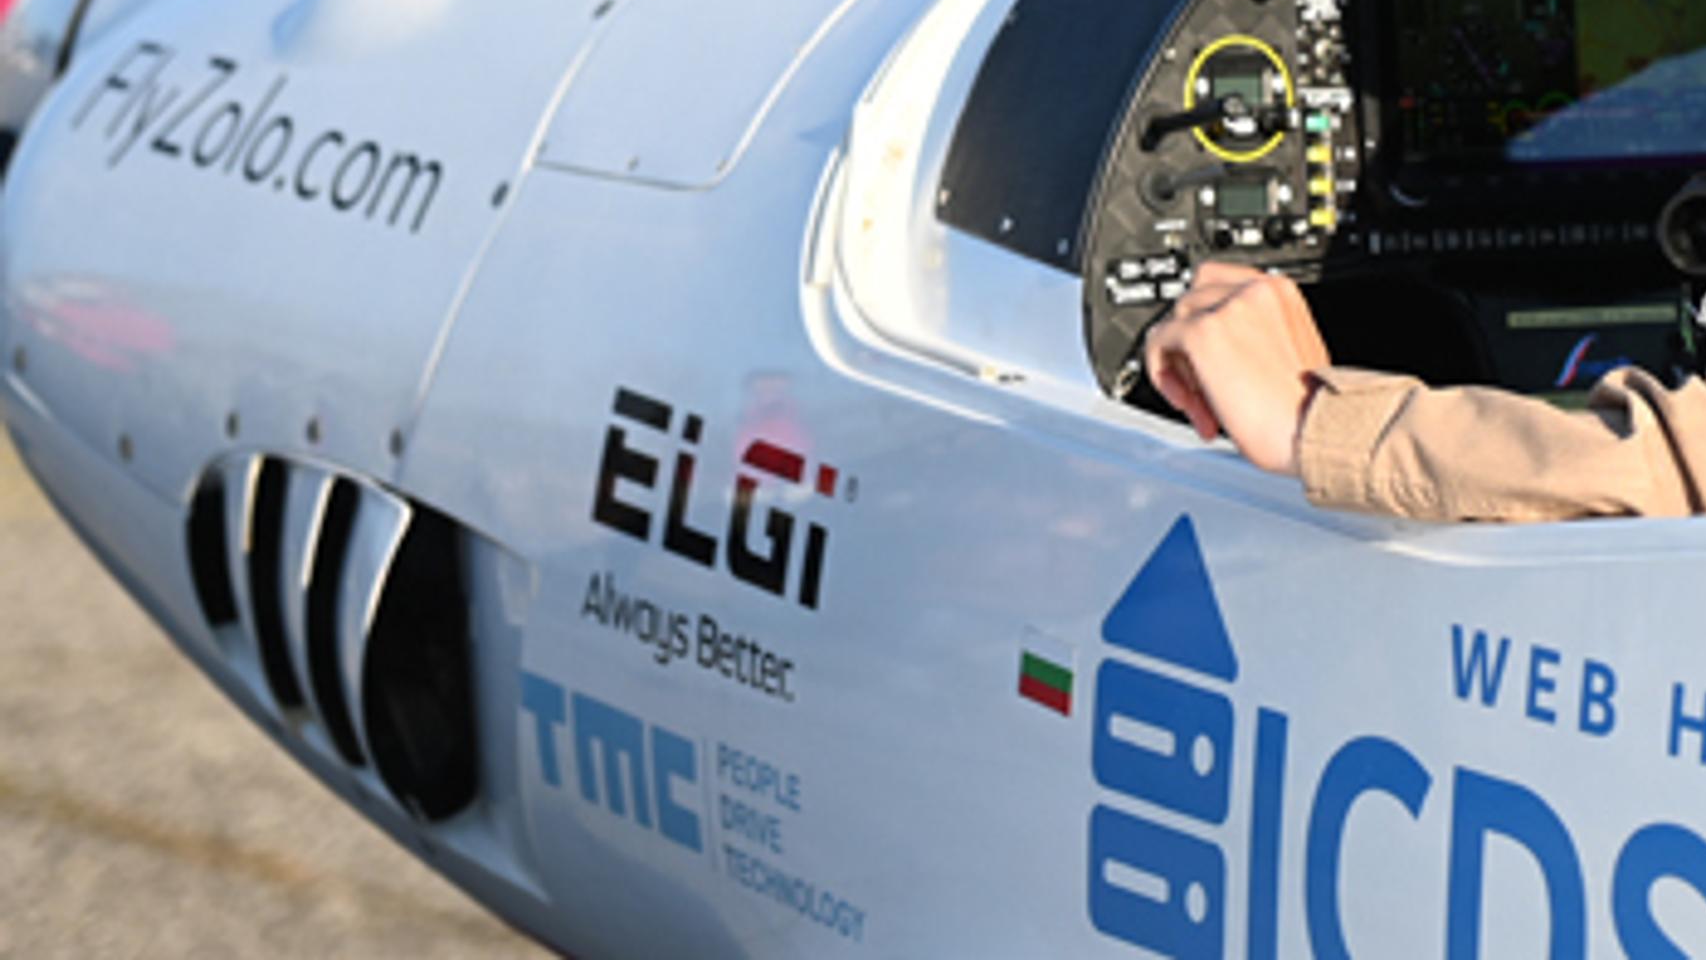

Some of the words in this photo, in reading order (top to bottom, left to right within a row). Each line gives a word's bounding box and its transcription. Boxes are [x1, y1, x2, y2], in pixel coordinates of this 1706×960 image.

[74, 41, 444, 234] FlyZolo.com
[580, 571, 692, 667] Always
[1450, 622, 1618, 737] WEB
[716, 742, 802, 813] PEOPLE
[719, 793, 784, 855] DRIVE
[722, 844, 868, 942] TECHNOLOGY
